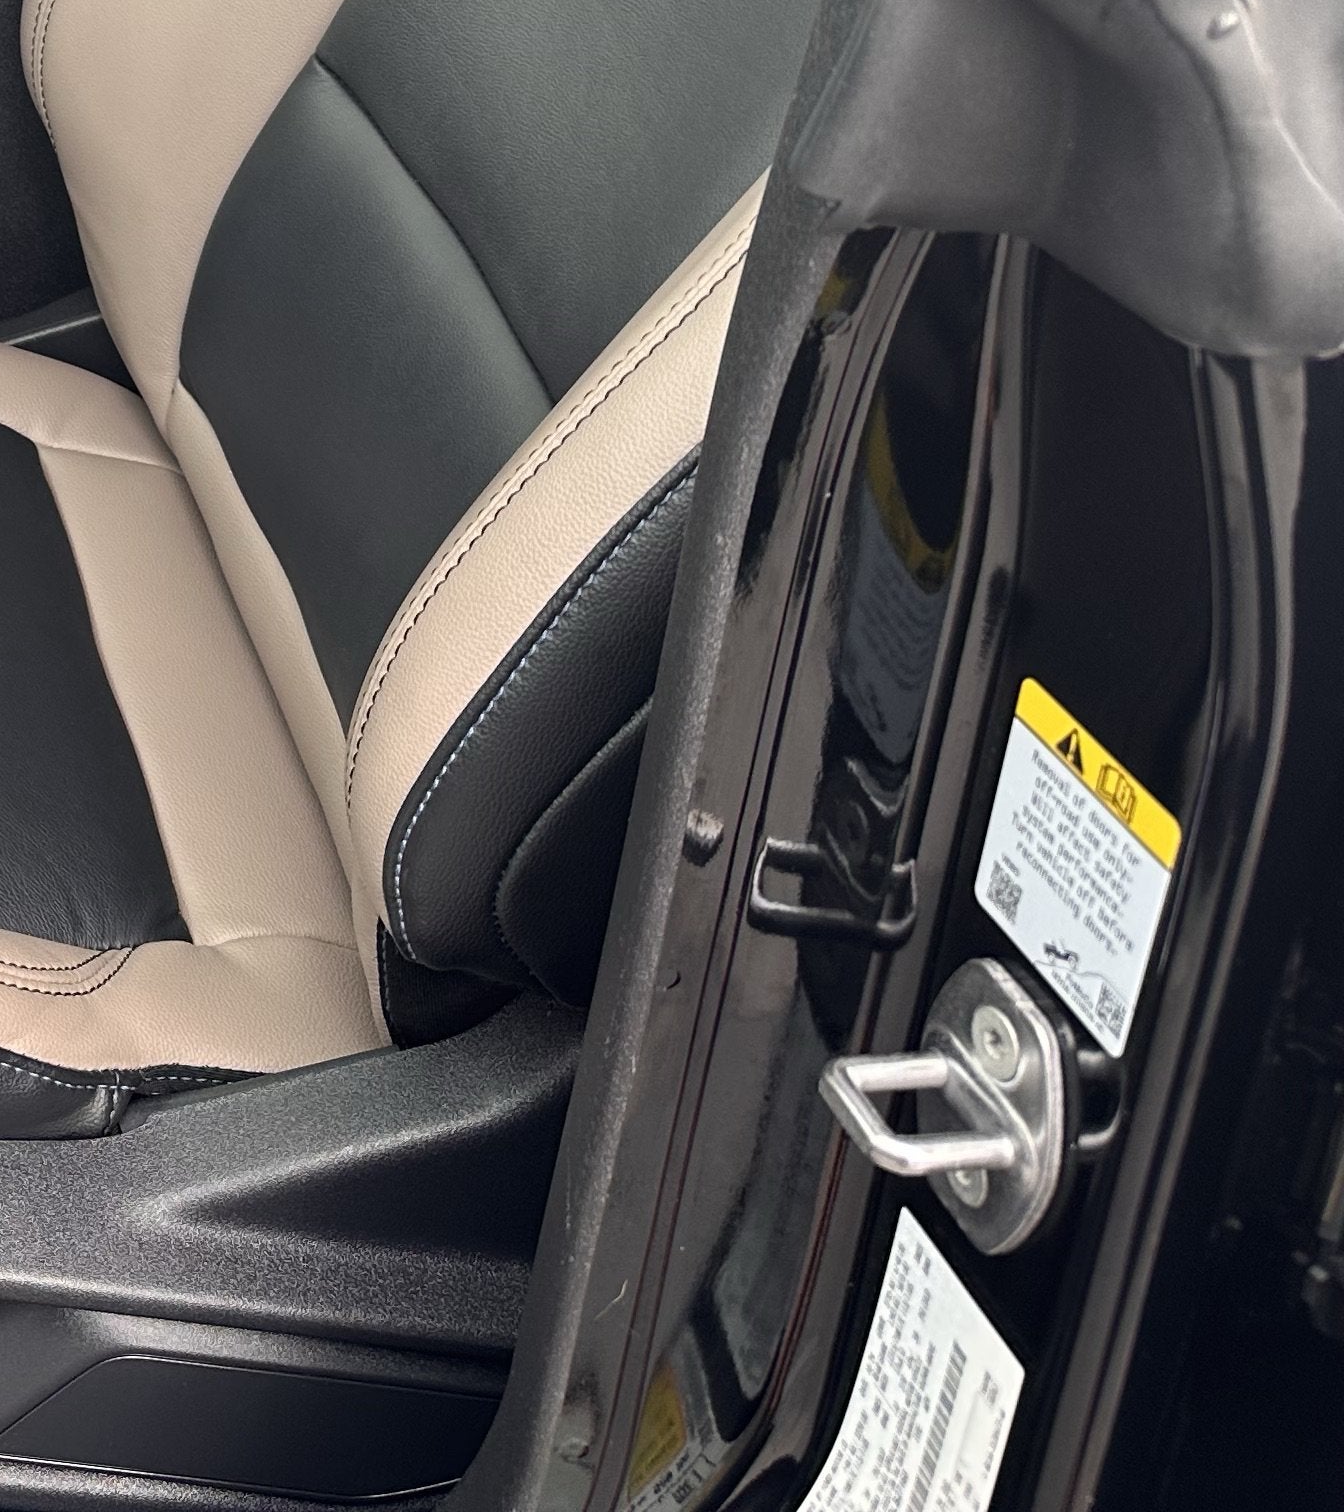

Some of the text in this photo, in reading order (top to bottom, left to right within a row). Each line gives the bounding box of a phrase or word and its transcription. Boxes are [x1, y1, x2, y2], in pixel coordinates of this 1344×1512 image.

[1021, 804, 1056, 845] system
[1031, 749, 1141, 866] Removal of doors for
[1035, 776, 1081, 828] off-road
[1082, 825, 1101, 850] use
[1012, 810, 1135, 953] Turn vehicle off before
[1015, 840, 1081, 921] reconnecting
[1057, 820, 1092, 861] affect
[1095, 860, 1132, 905] safety
